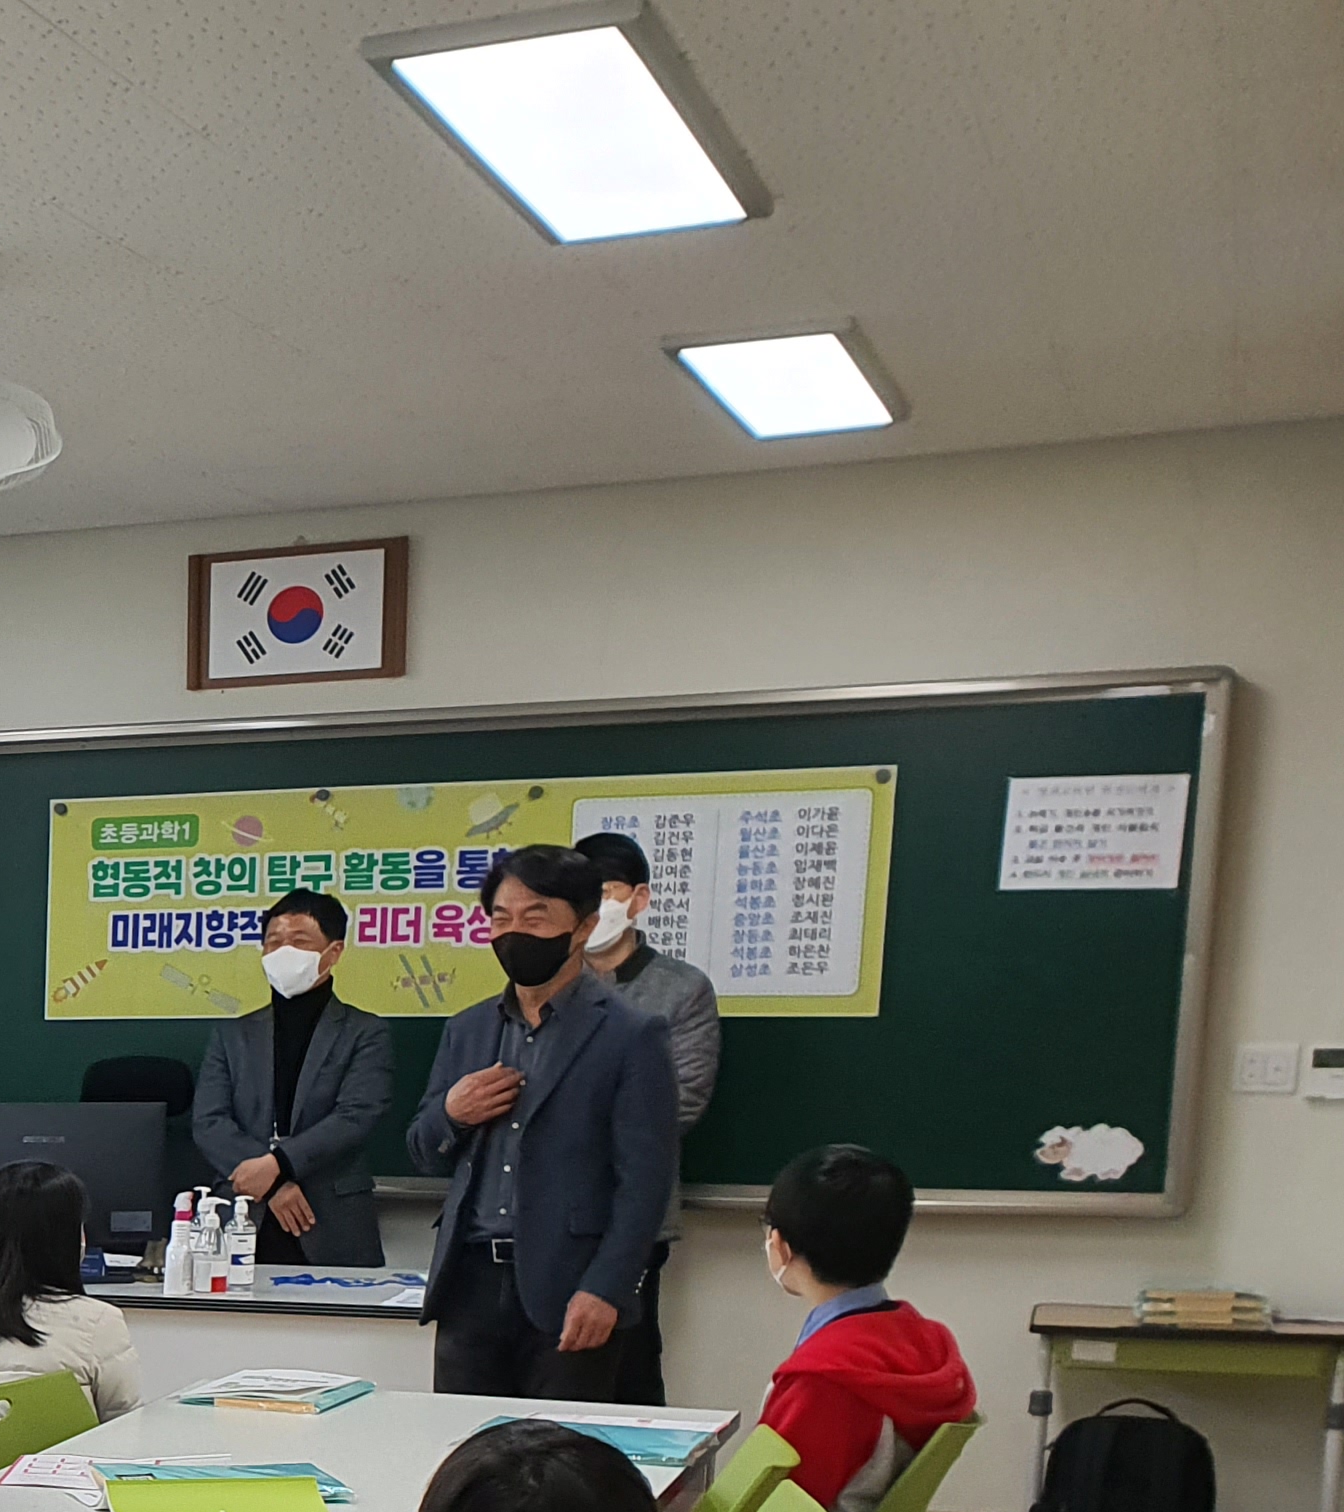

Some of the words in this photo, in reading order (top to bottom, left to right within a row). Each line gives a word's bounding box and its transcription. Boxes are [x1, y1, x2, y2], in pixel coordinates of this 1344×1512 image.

[98, 820, 192, 844] 초등과학1
[91, 857, 183, 898] 협동적
[191, 855, 257, 896] 창의
[267, 854, 333, 893] 탐구
[343, 850, 447, 891] 활동을
[358, 906, 421, 943] 리더
